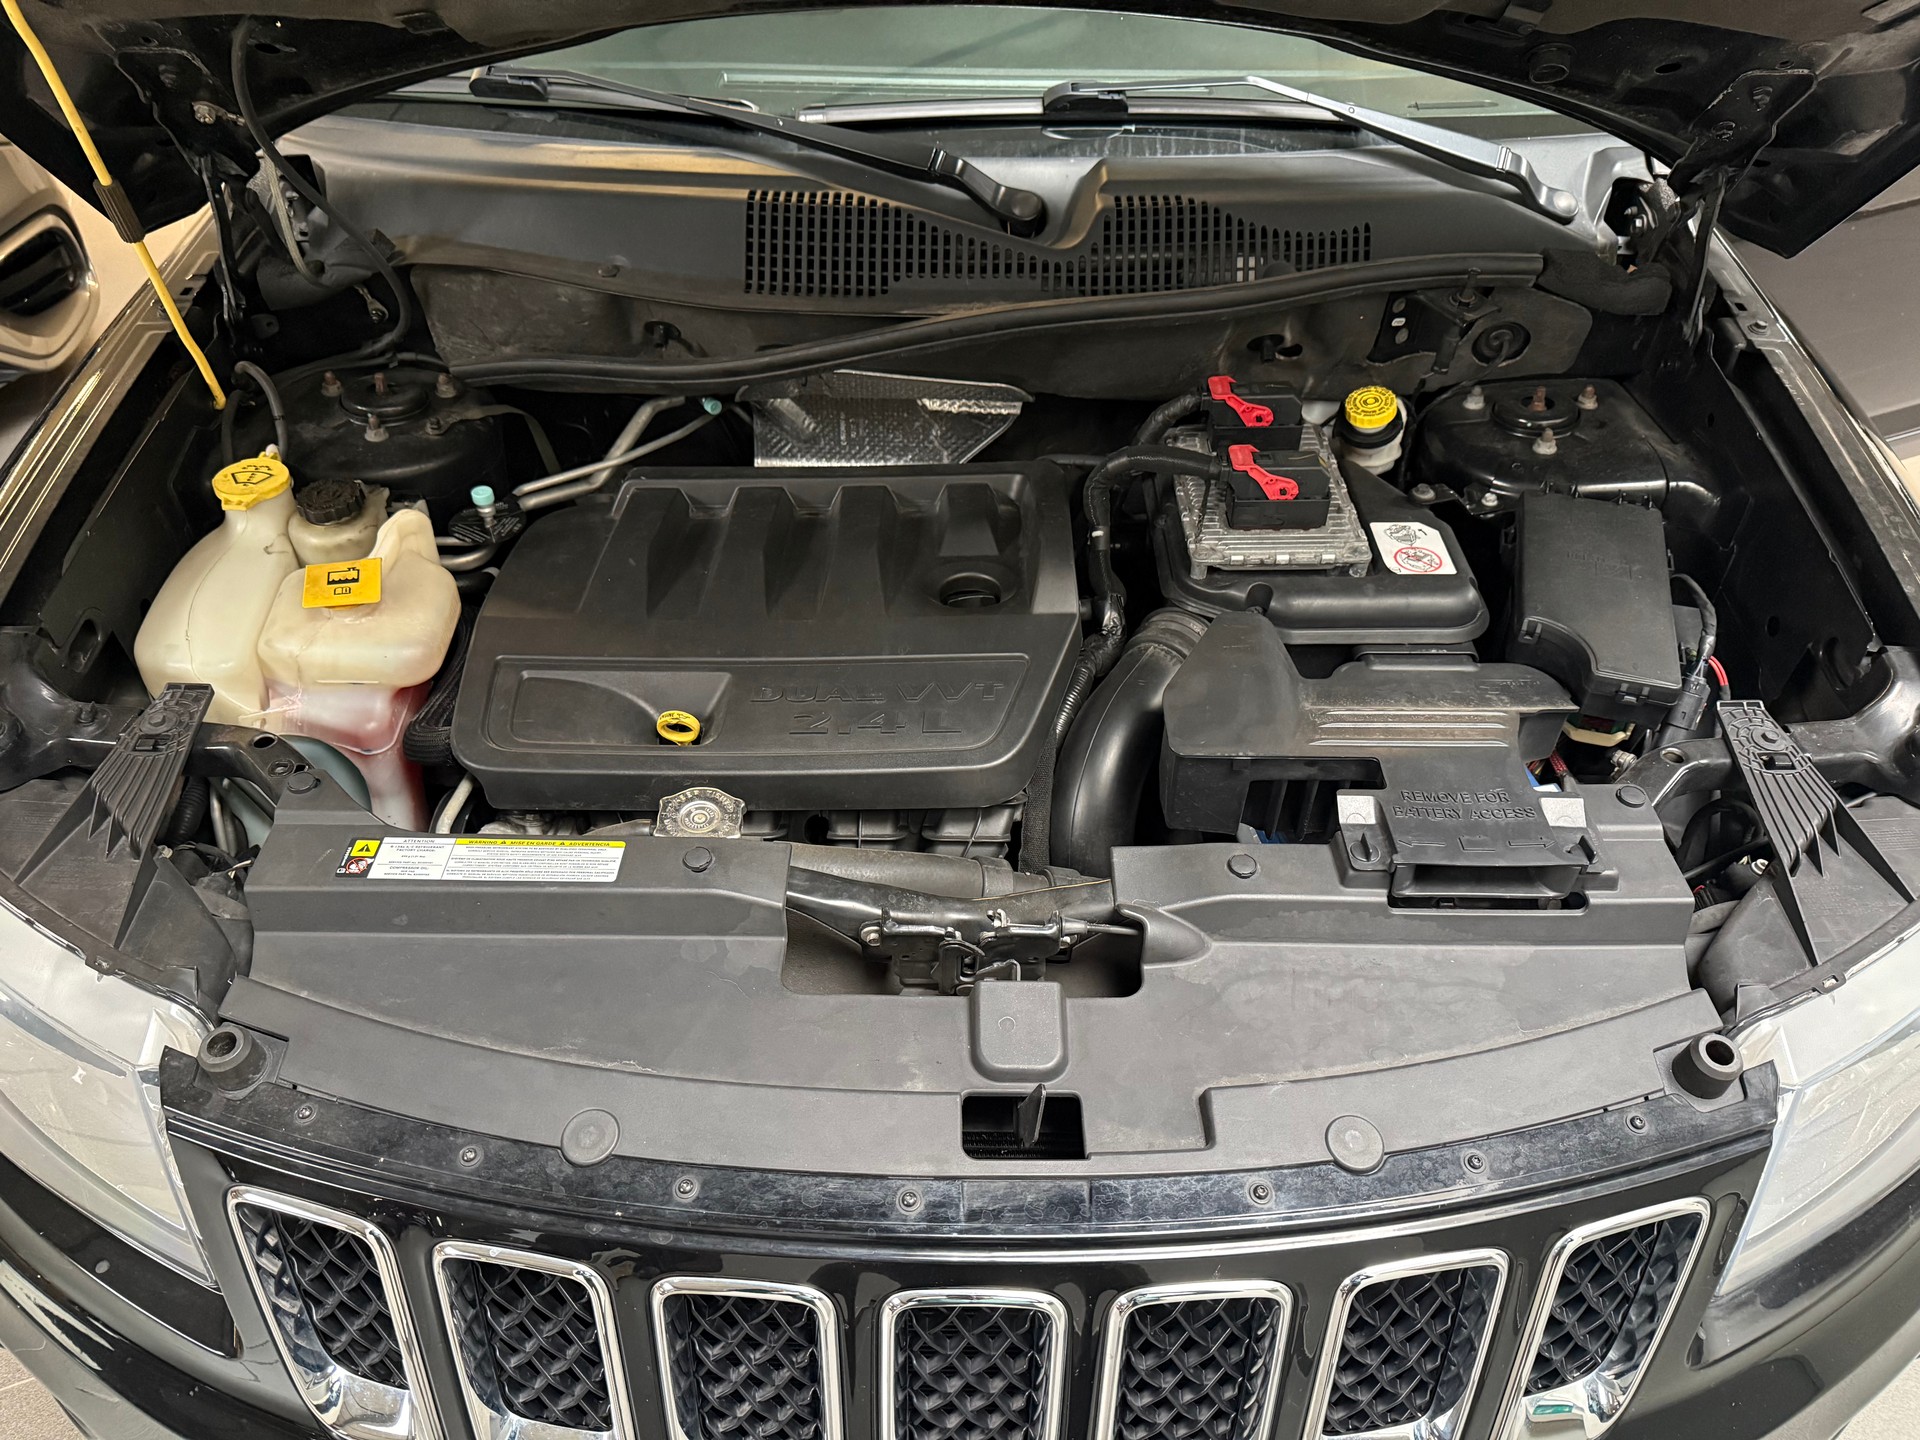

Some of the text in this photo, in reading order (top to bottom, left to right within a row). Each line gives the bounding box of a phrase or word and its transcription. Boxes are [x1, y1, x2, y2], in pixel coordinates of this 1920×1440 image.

[750, 681, 1004, 703] DUAL VVT
[1400, 790, 1510, 805] REMOVE FOR
[1393, 805, 1536, 820] BATTERY ACCESS
